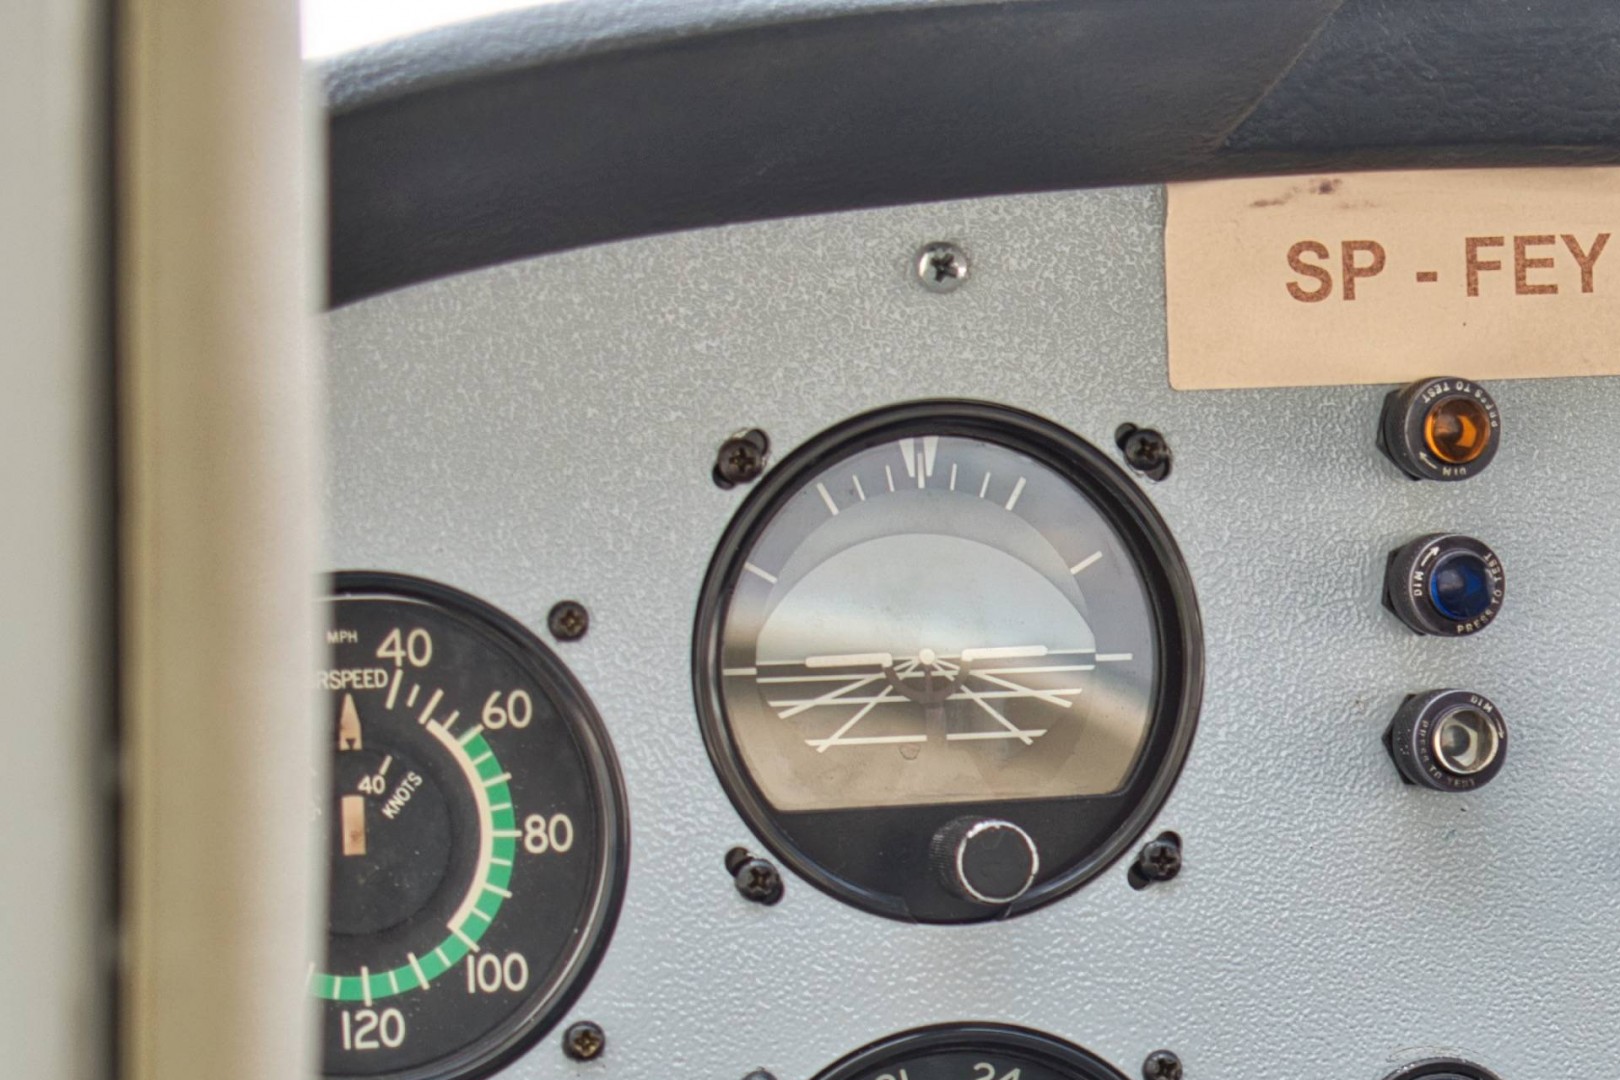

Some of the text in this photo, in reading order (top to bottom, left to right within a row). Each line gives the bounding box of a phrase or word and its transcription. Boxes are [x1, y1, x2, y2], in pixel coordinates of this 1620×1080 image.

[1285, 240, 1387, 303] SP
[1464, 232, 1611, 297] FEY
[327, 631, 358, 643] MPH
[377, 629, 433, 666] 40
[317, 668, 388, 690] RSPEED
[482, 690, 532, 728] 60
[358, 774, 385, 796] 40
[382, 772, 424, 820] KNOTS
[523, 815, 573, 853] 80
[468, 953, 528, 993] 100
[342, 1009, 406, 1049] 120
